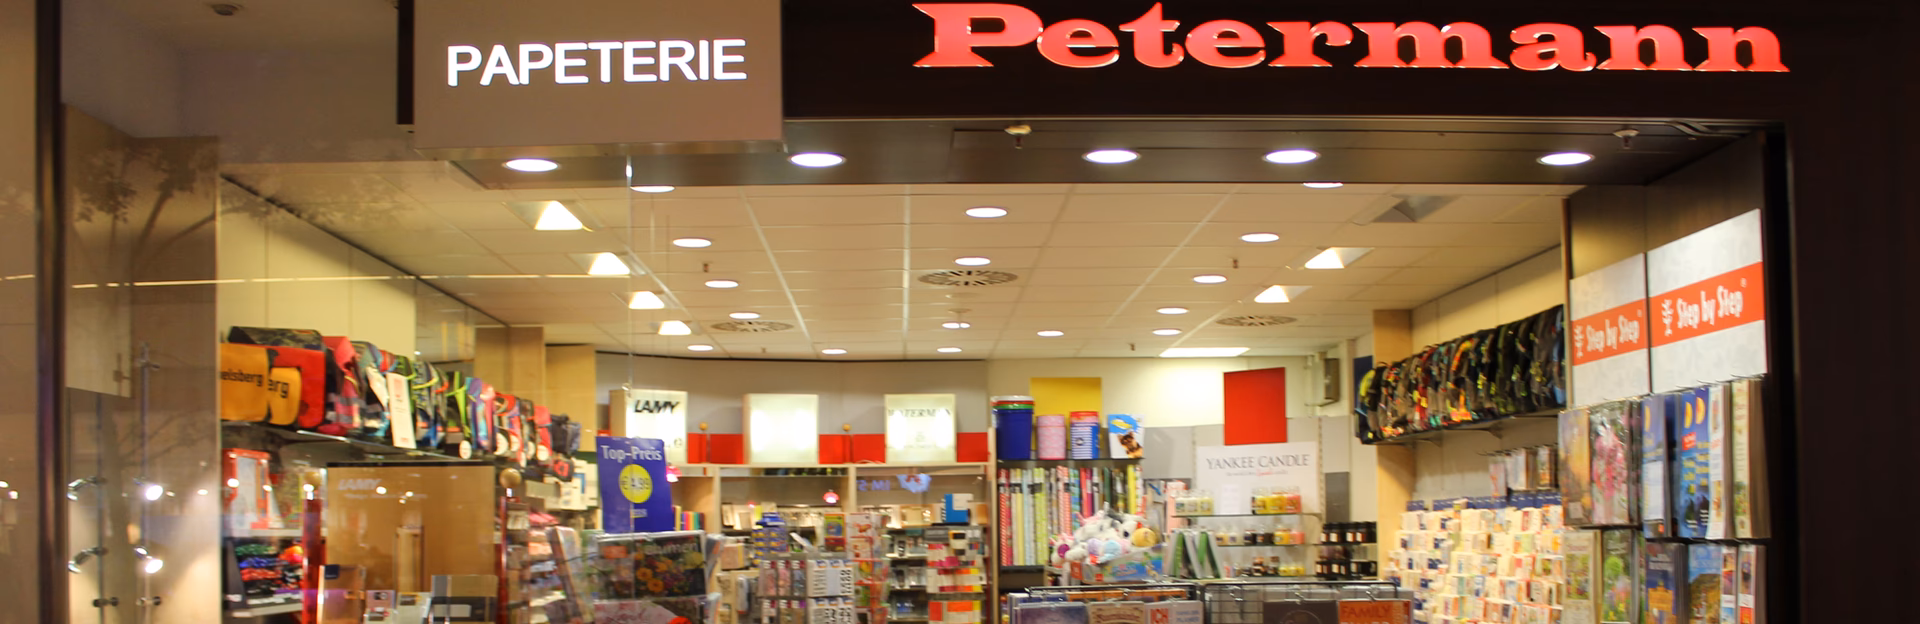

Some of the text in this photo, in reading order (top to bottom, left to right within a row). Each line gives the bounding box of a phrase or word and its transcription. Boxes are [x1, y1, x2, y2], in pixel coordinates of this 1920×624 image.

[912, 2, 1790, 73] Petermann
[447, 38, 748, 87] PAPETERIE
[1676, 285, 1743, 329] Step by Step
[1586, 314, 1640, 352] Step by Step
[634, 399, 679, 414] LAMY
[600, 445, 662, 463] Top-Preis
[1206, 454, 1310, 470] YANKEE CANDLE
[337, 478, 381, 490] LAMY
[1341, 604, 1391, 617] FAMILY
